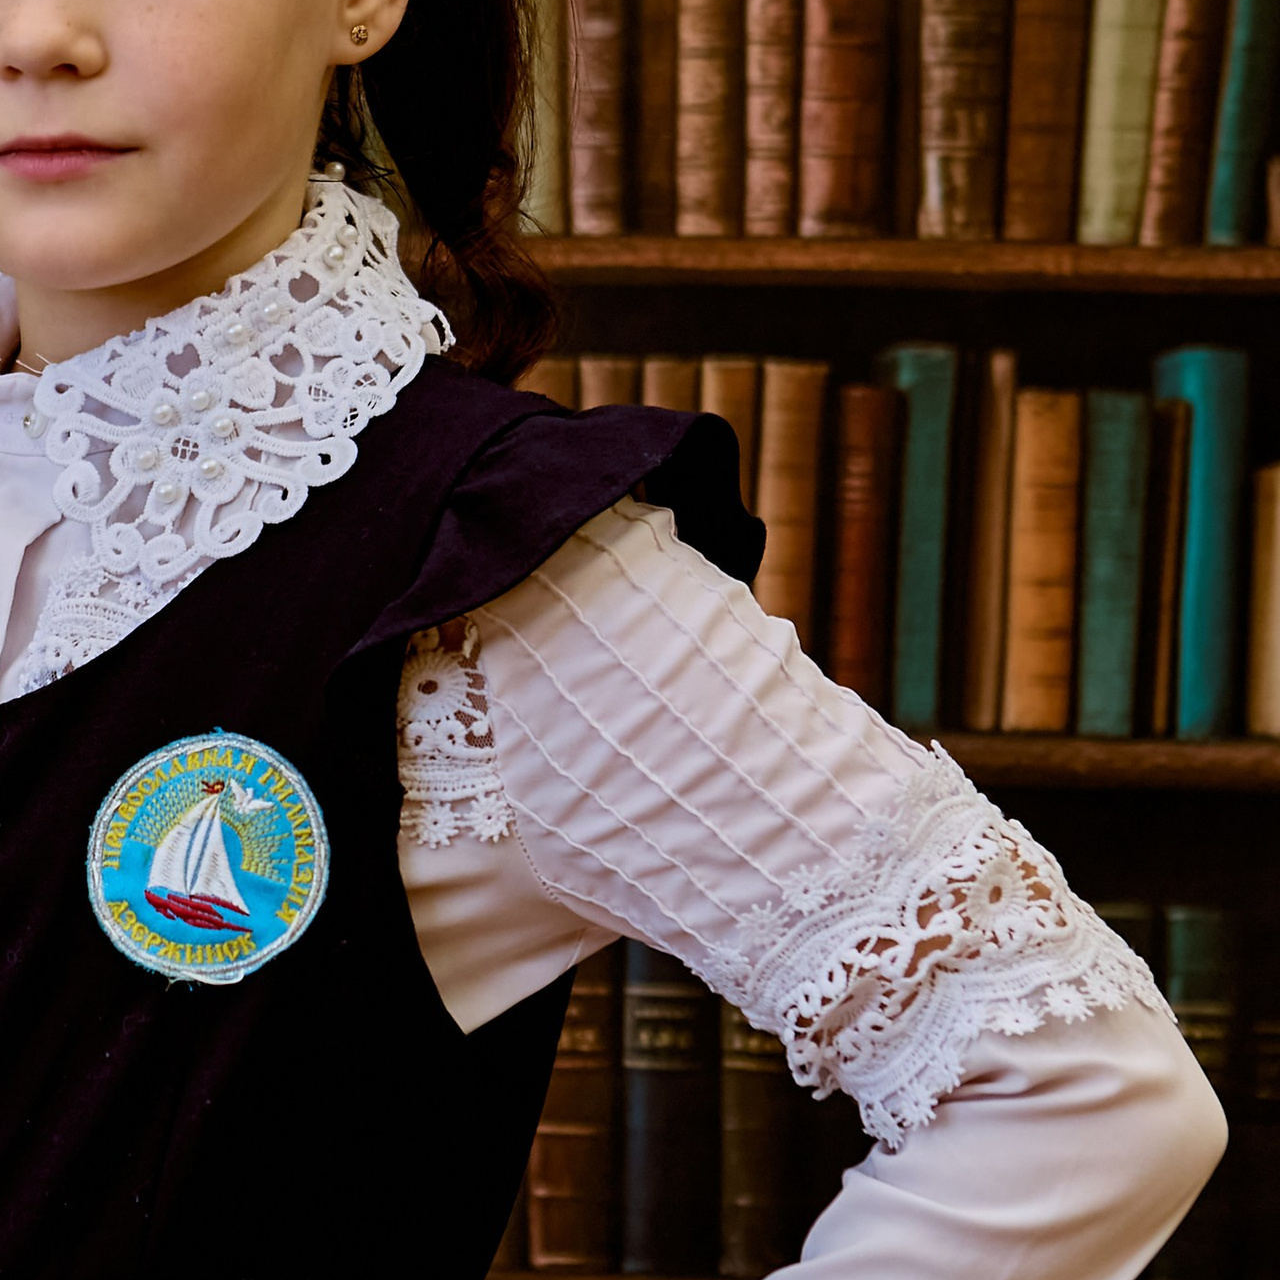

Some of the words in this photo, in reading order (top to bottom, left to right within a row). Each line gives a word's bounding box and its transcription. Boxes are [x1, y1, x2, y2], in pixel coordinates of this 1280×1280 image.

[102, 748, 258, 871] ПРАВОСЛАВНАЯ
[257, 766, 315, 926] ГИМНАЗИЯ
[106, 899, 257, 965] ДЗЕРЖИНСК
